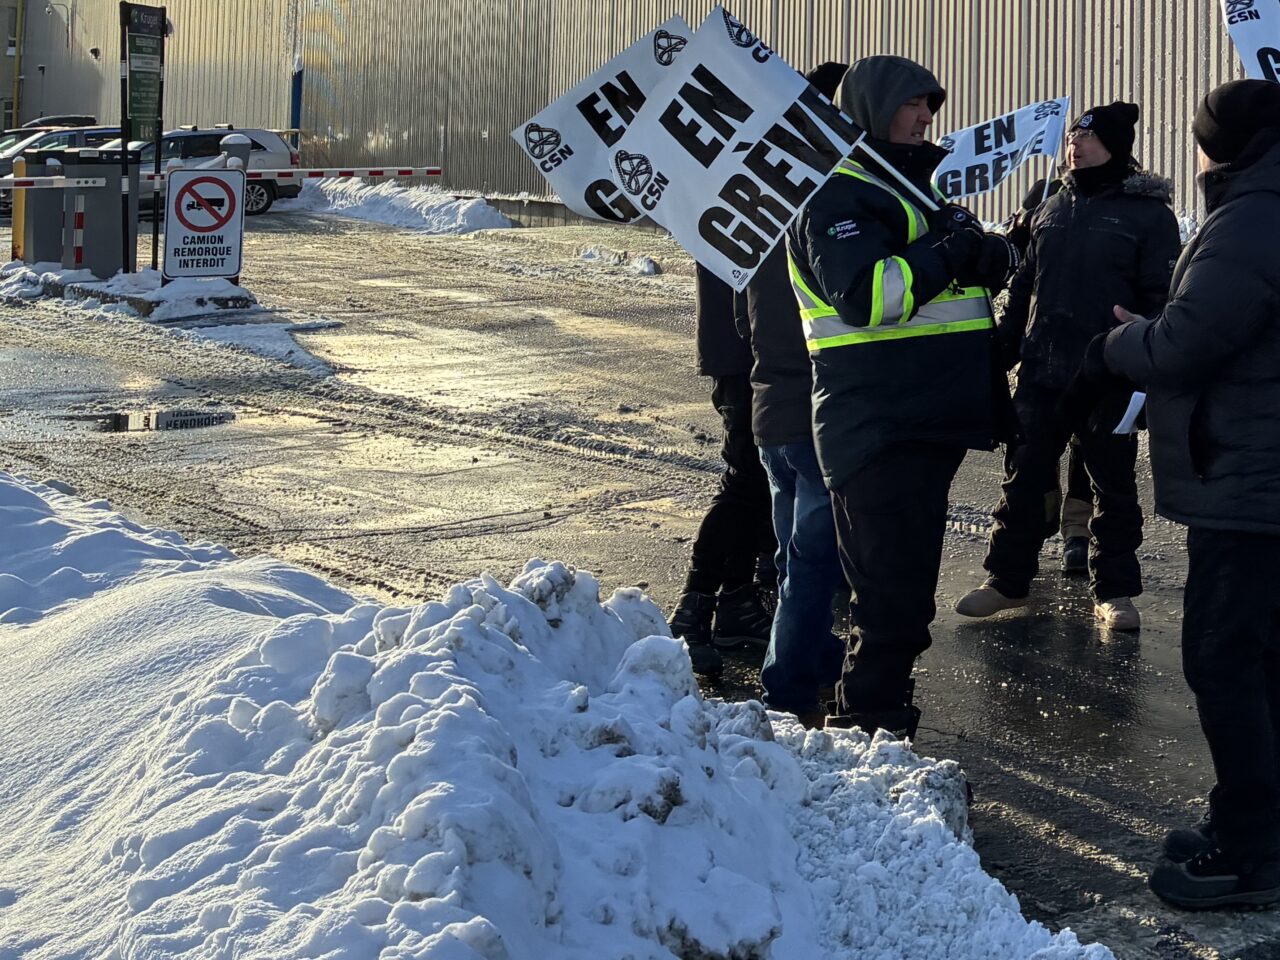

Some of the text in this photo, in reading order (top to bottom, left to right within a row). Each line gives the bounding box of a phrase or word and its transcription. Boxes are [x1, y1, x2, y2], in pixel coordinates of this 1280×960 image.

[1228, 9, 1261, 25] CSN
[576, 70, 647, 148] EN
[658, 63, 755, 169] EN
[1034, 110, 1060, 120] CSN
[974, 114, 1016, 156] EN
[540, 144, 575, 173] CSN
[641, 171, 670, 211] CSN
[698, 84, 867, 269] GRÈVE
[173, 246, 232, 257] REMORQUE
[182, 235, 224, 246] CAMION
[179, 258, 226, 269] INTERDIT
